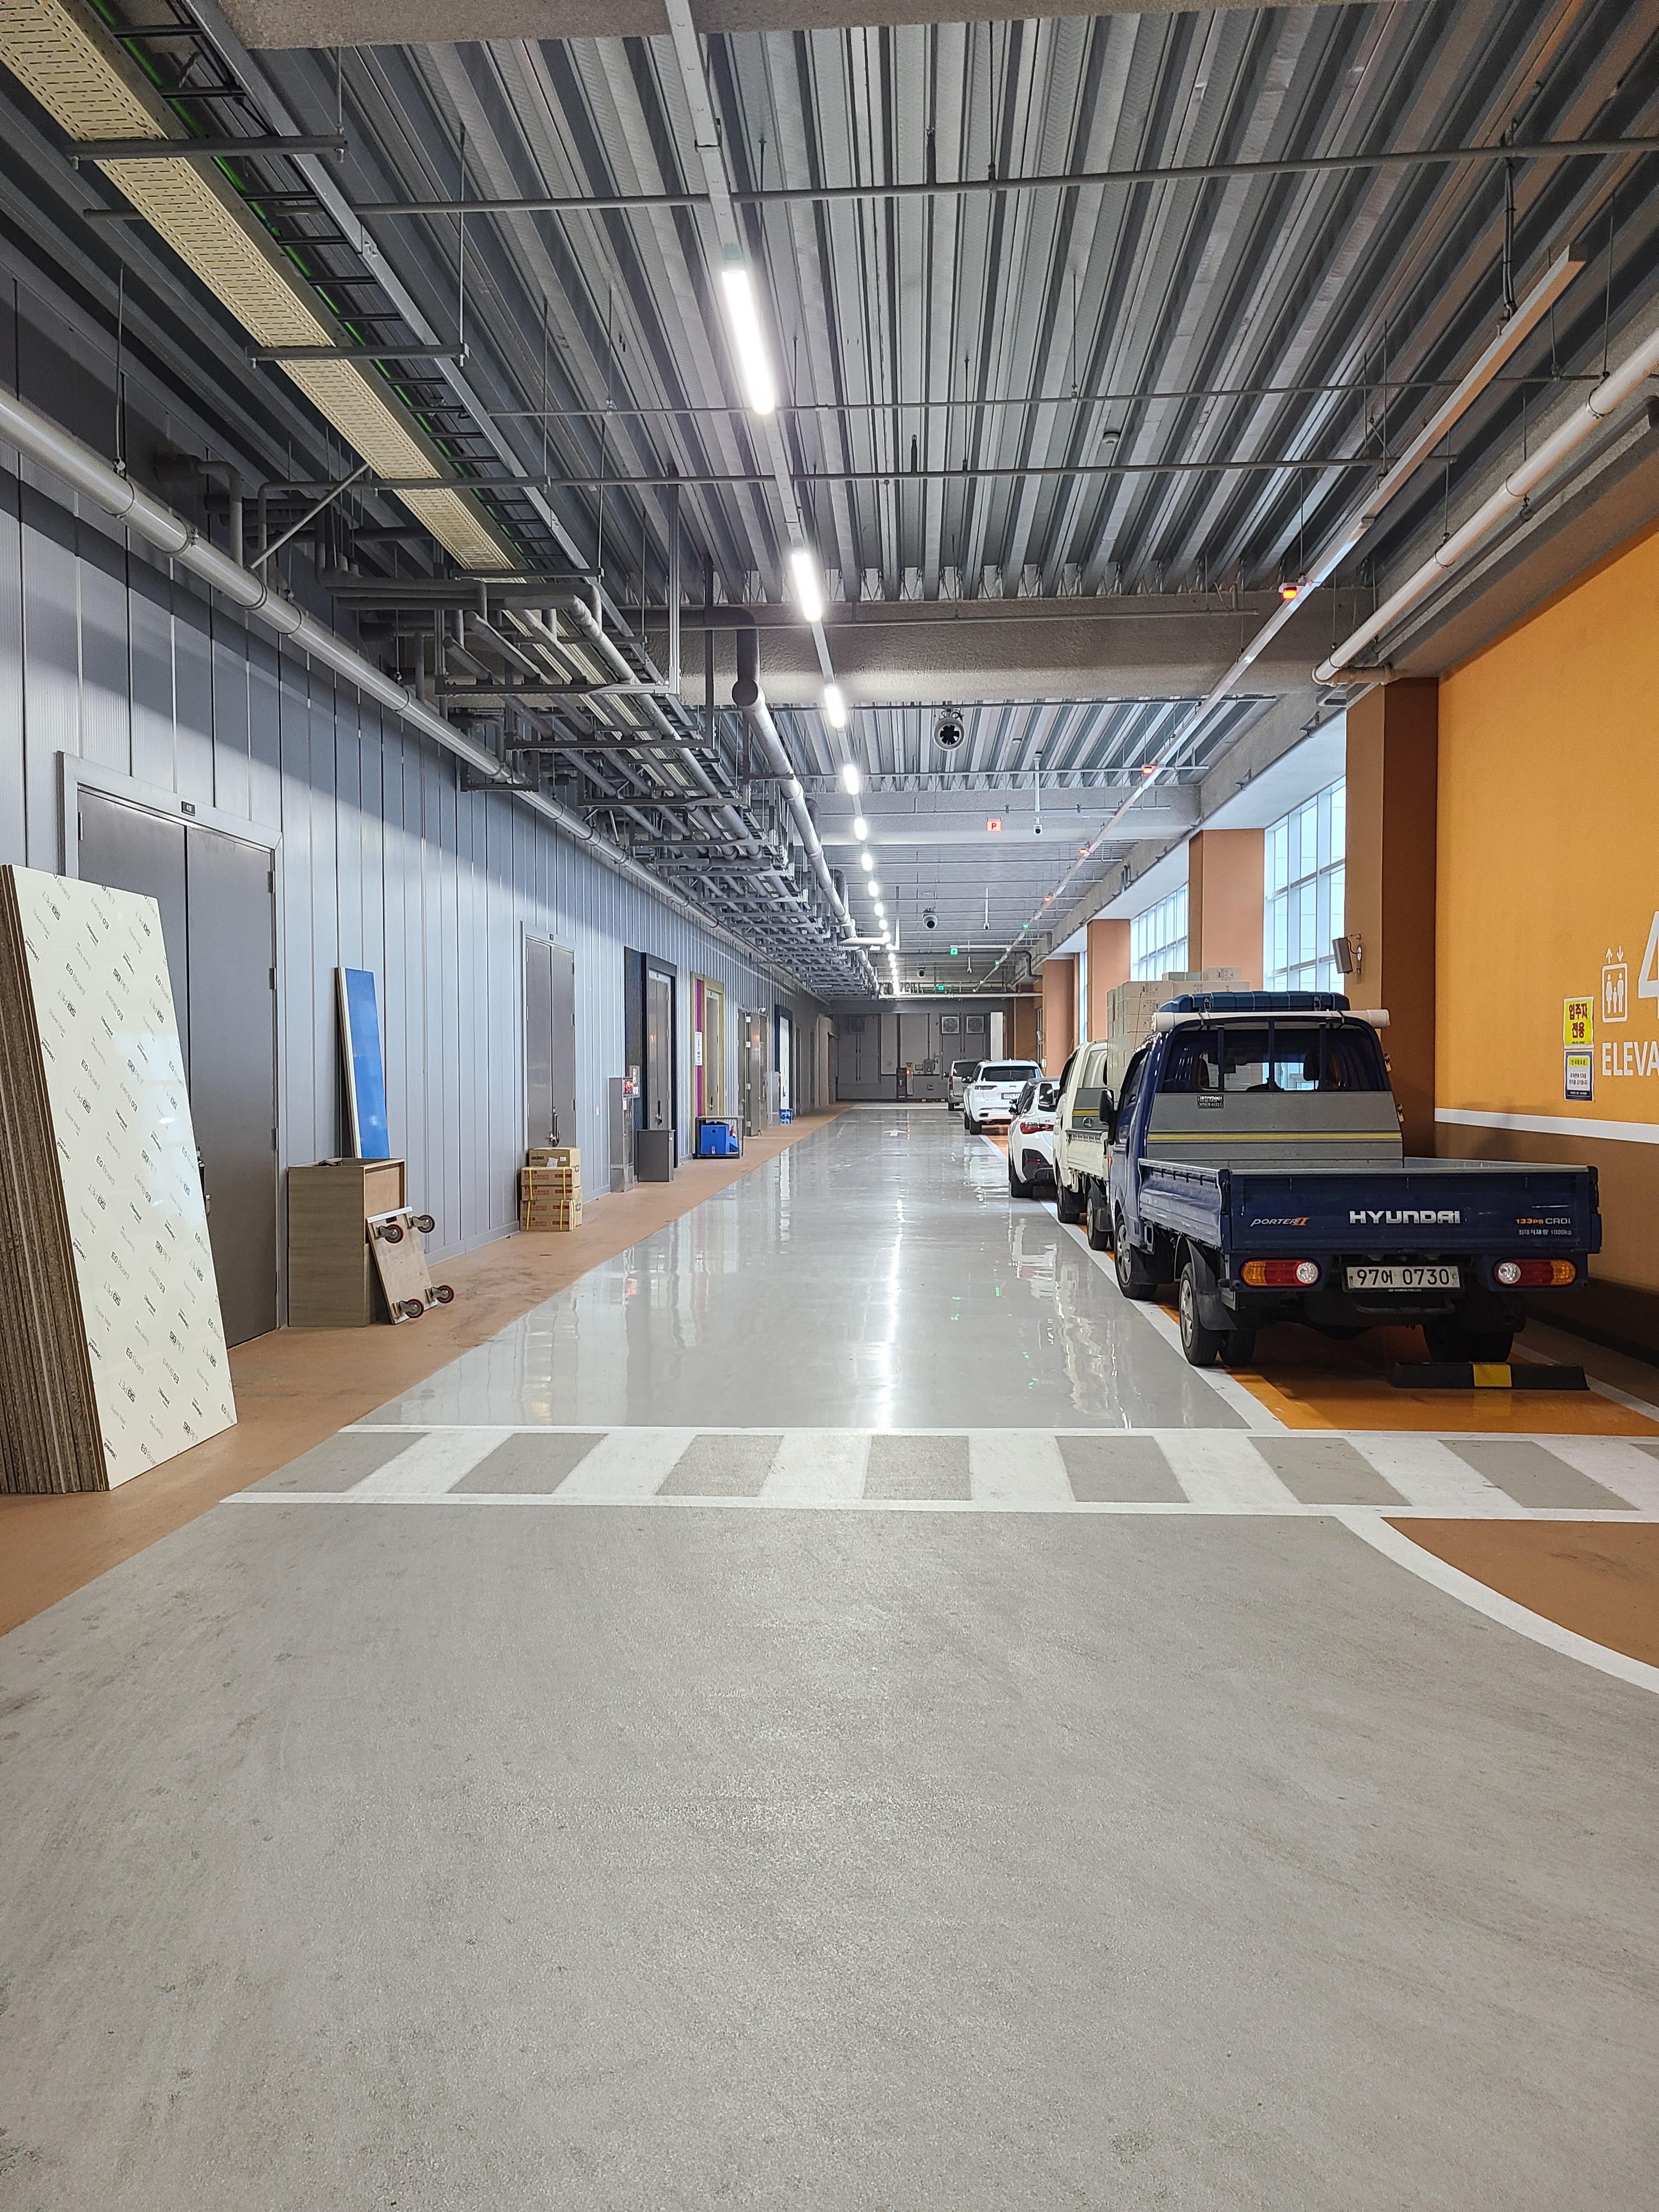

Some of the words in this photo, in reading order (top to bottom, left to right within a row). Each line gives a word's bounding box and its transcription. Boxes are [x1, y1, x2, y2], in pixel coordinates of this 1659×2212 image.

[1571, 1022, 1585, 1039] 전용
[1349, 1210, 1460, 1224] HYUNDAI
[1357, 1269, 1393, 1285] 97어
[1402, 1268, 1449, 1285] 0730
